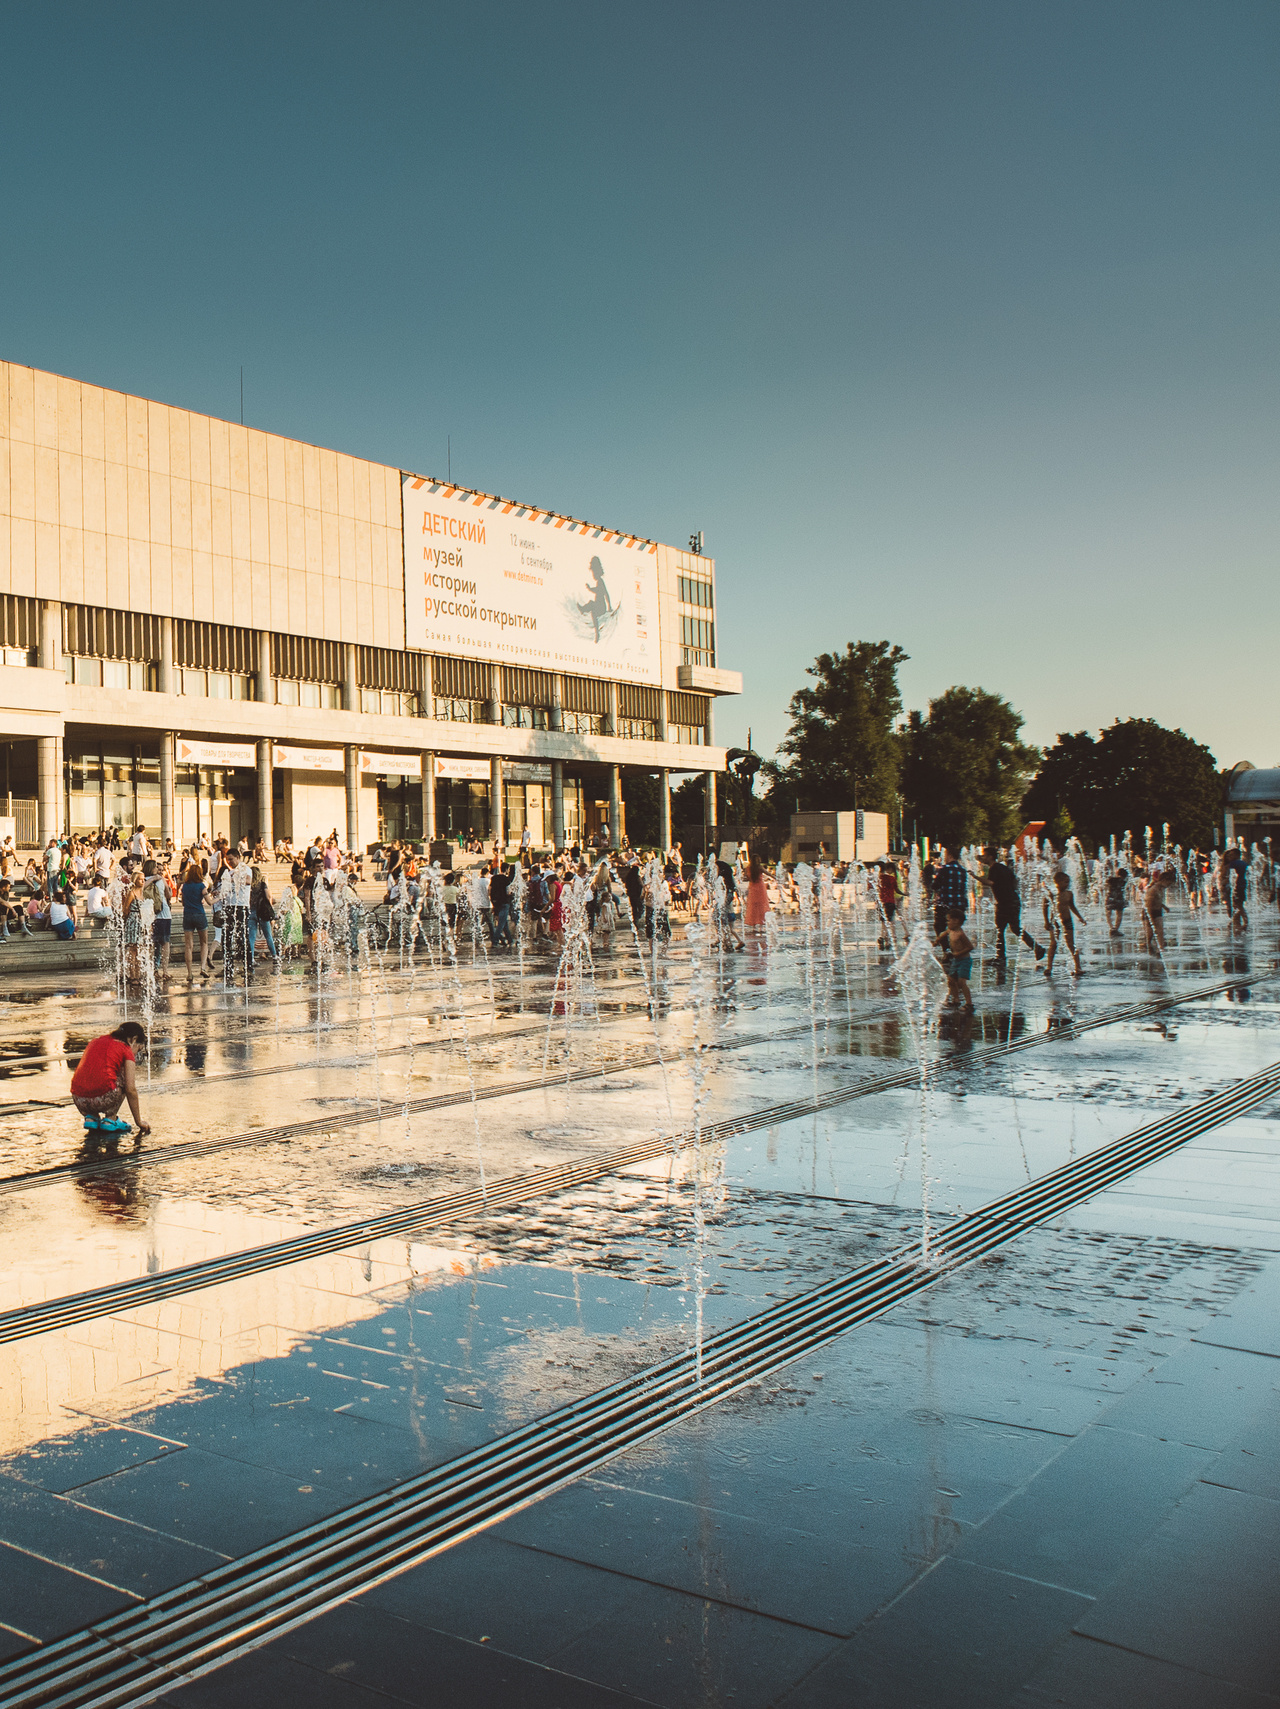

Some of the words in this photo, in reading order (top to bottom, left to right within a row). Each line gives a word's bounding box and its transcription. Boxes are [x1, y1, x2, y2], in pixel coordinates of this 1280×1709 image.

[422, 511, 486, 545] ДЕТСКИЙ
[510, 533, 518, 547] 12
[423, 546, 463, 569] музей
[521, 552, 525, 565] 6
[526, 556, 553, 574] сентября
[424, 572, 477, 598] истории
[424, 597, 477, 619] русской
[479, 607, 537, 631] открытки
[425, 628, 452, 643] Самая
[456, 634, 492, 649] большая
[496, 643, 550, 659] историческая
[554, 652, 588, 665] выставка
